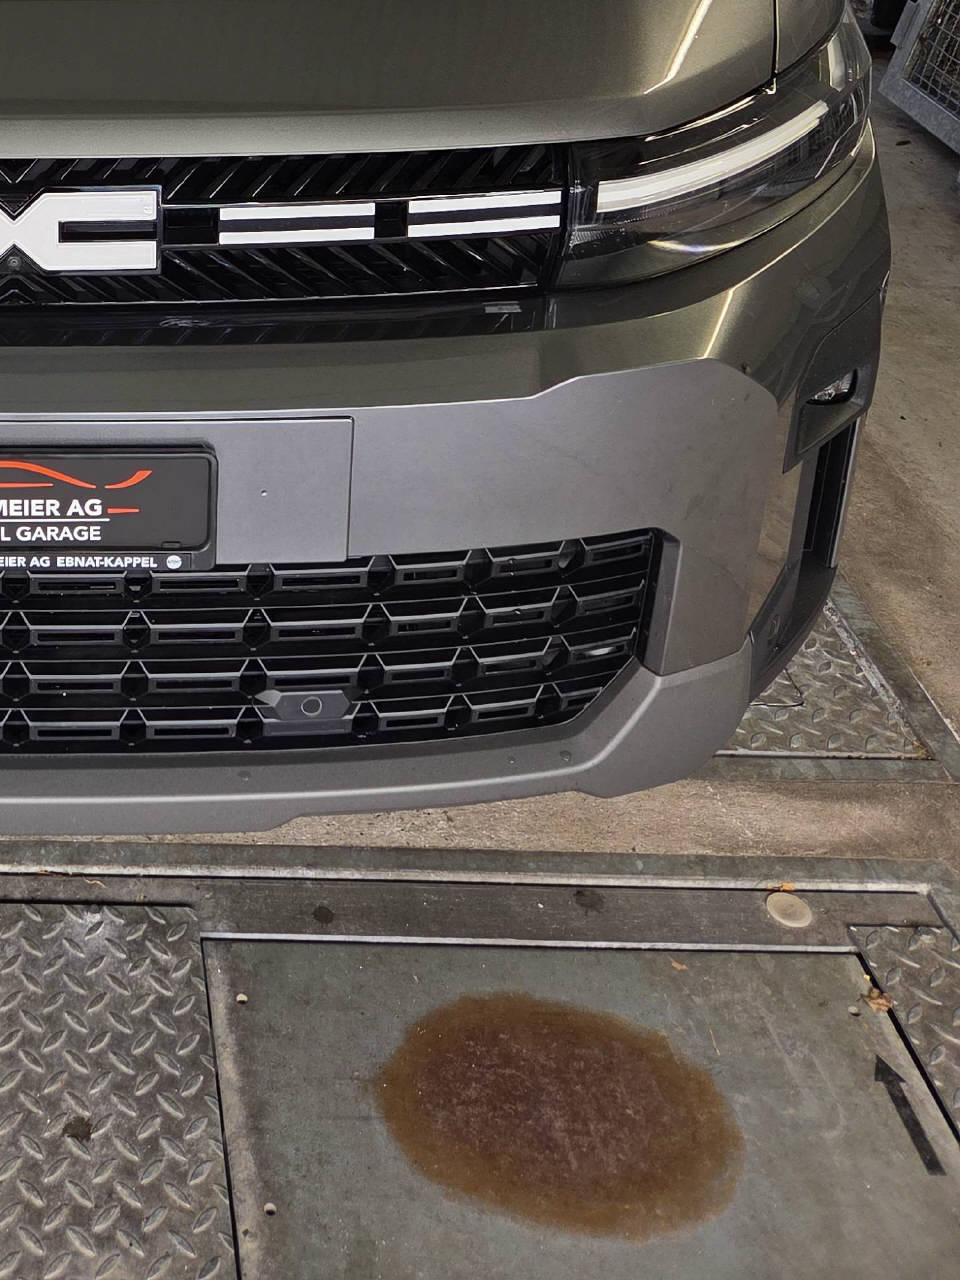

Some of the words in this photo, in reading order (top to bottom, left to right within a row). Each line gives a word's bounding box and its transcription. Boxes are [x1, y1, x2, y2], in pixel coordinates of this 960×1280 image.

[66, 498, 103, 517] AG
[15, 525, 102, 542] GARAGE
[29, 556, 51, 568] AG
[56, 556, 158, 568] EBNAT-KAPPEL
